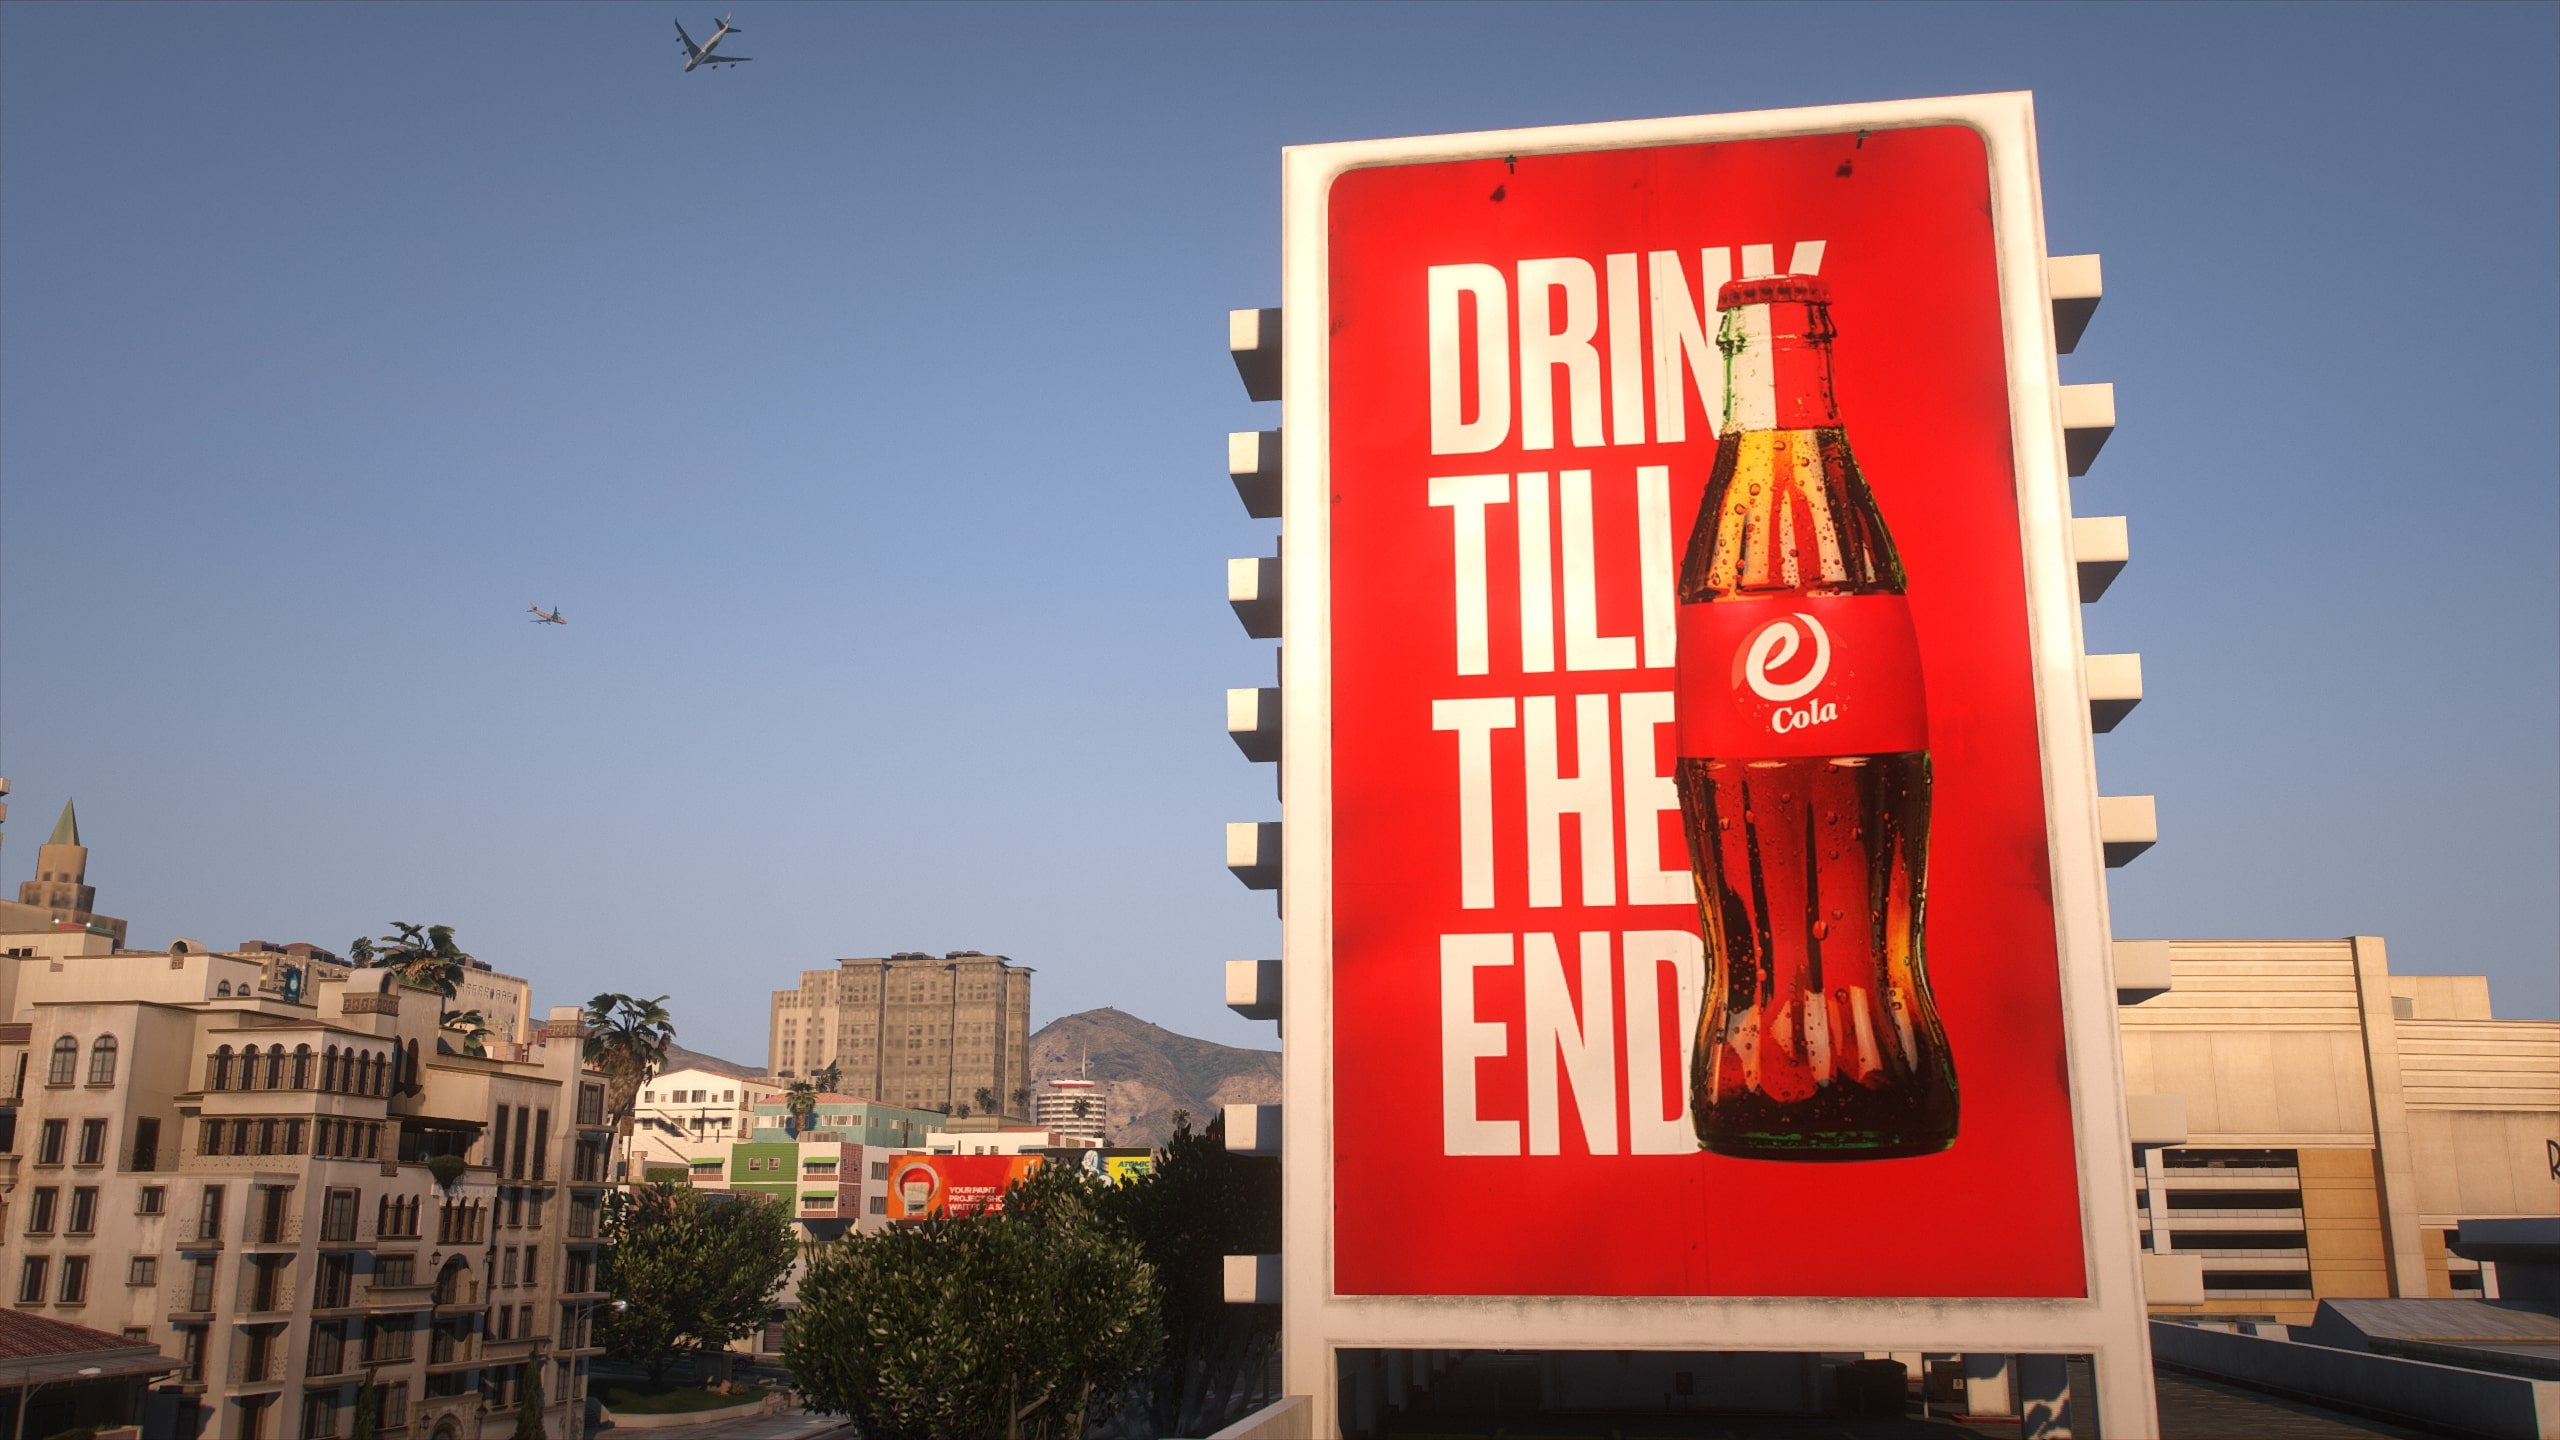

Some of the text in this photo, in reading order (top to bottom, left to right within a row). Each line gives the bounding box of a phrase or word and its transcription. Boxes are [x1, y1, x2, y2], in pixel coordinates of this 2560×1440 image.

[1771, 698, 1838, 734] Cola
[1432, 691, 1699, 909] THE
[1440, 930, 1704, 1156] END
[1117, 1160, 1150, 1168] ATOMIC
[949, 1186, 996, 1194] YOUR PAINT
